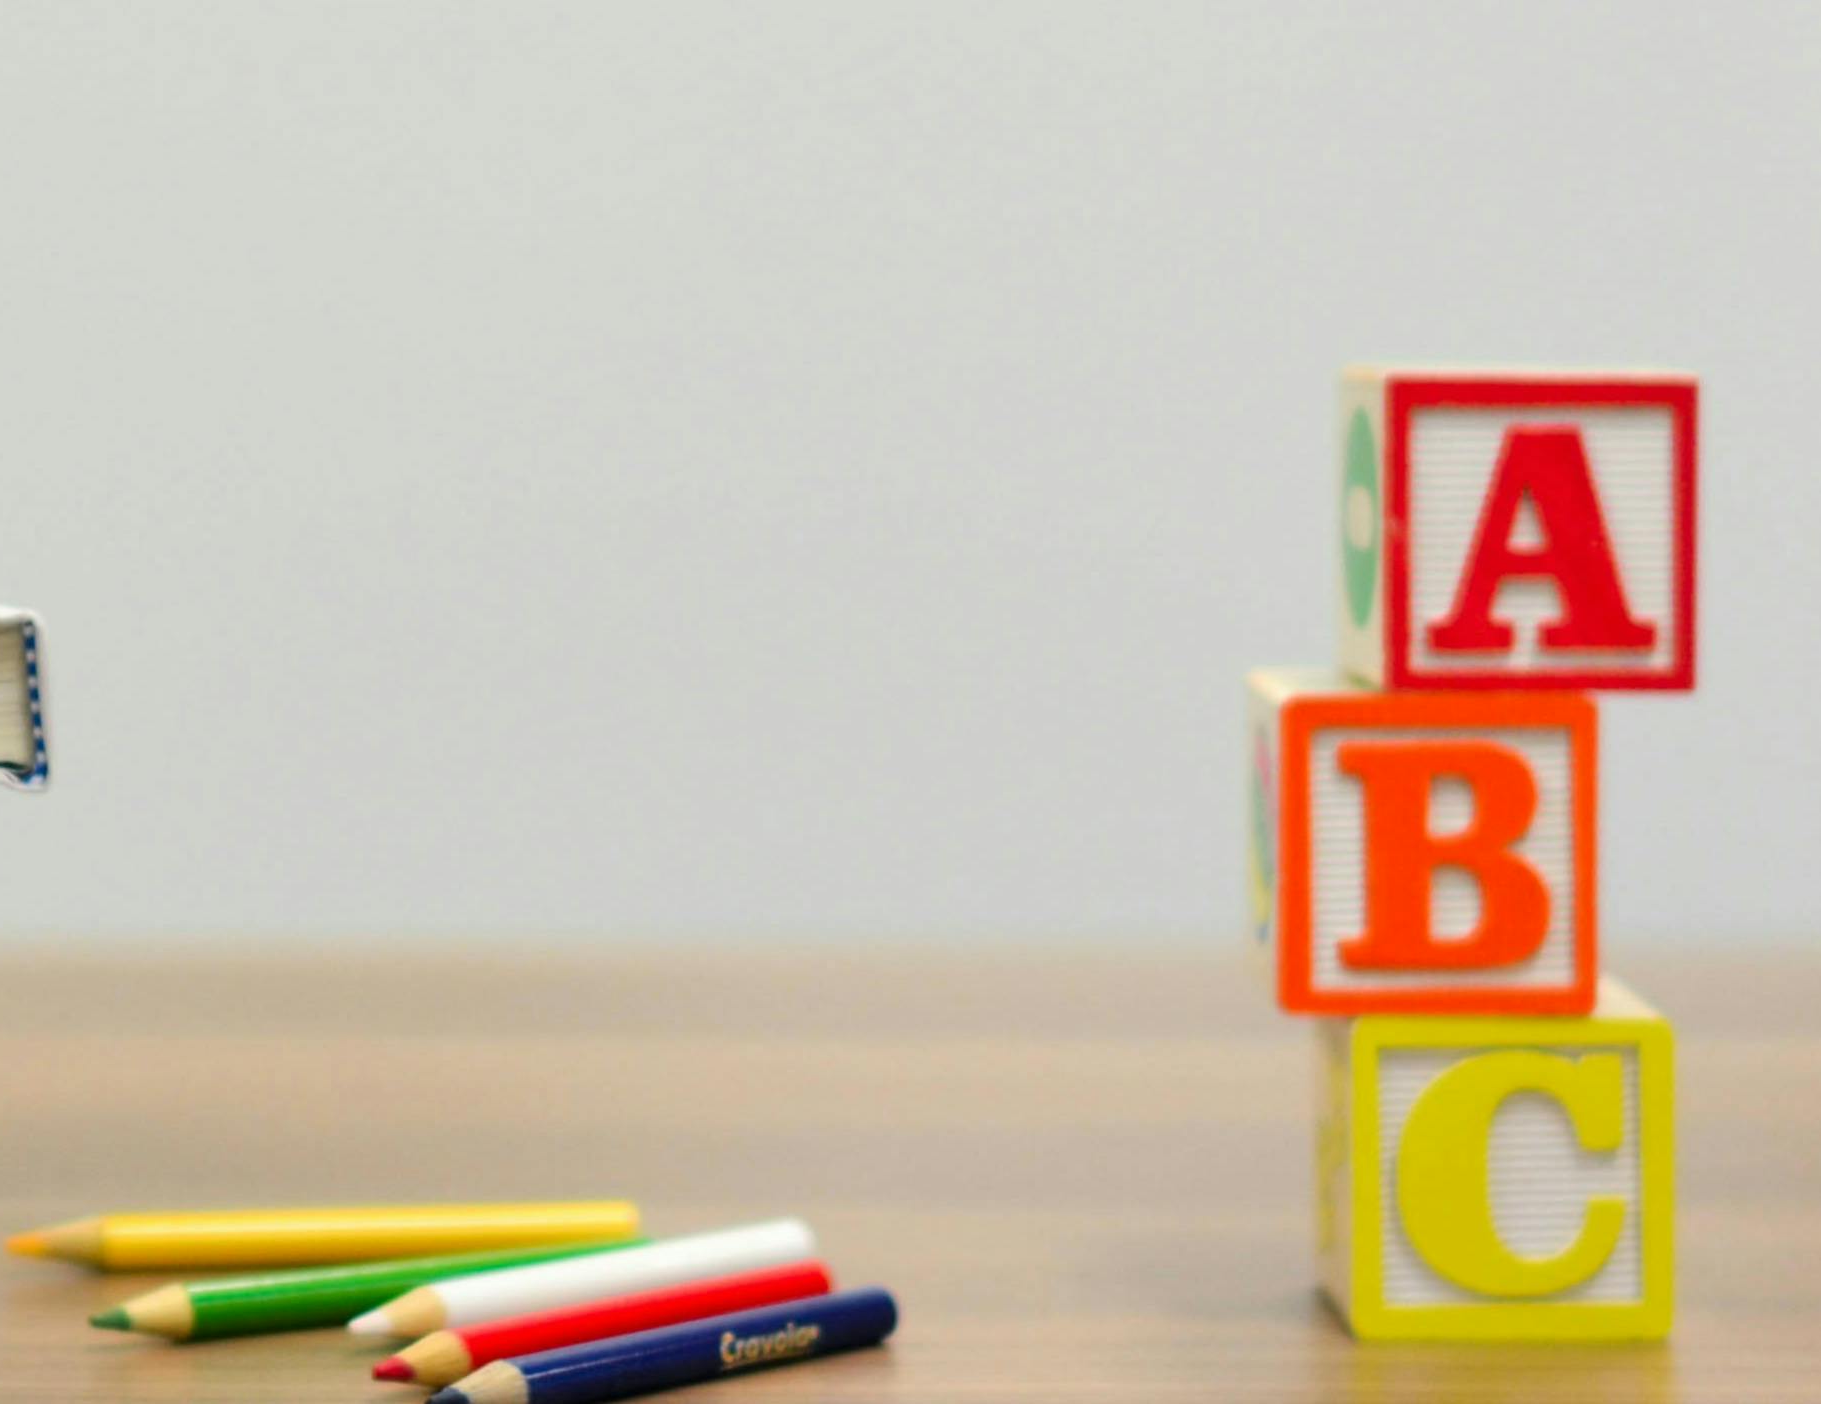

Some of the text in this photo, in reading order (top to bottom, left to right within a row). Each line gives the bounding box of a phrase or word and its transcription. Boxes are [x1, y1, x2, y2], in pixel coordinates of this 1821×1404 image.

[1426, 424, 1656, 654] A
[1337, 741, 1550, 971] B
[1397, 1049, 1625, 1297] C
